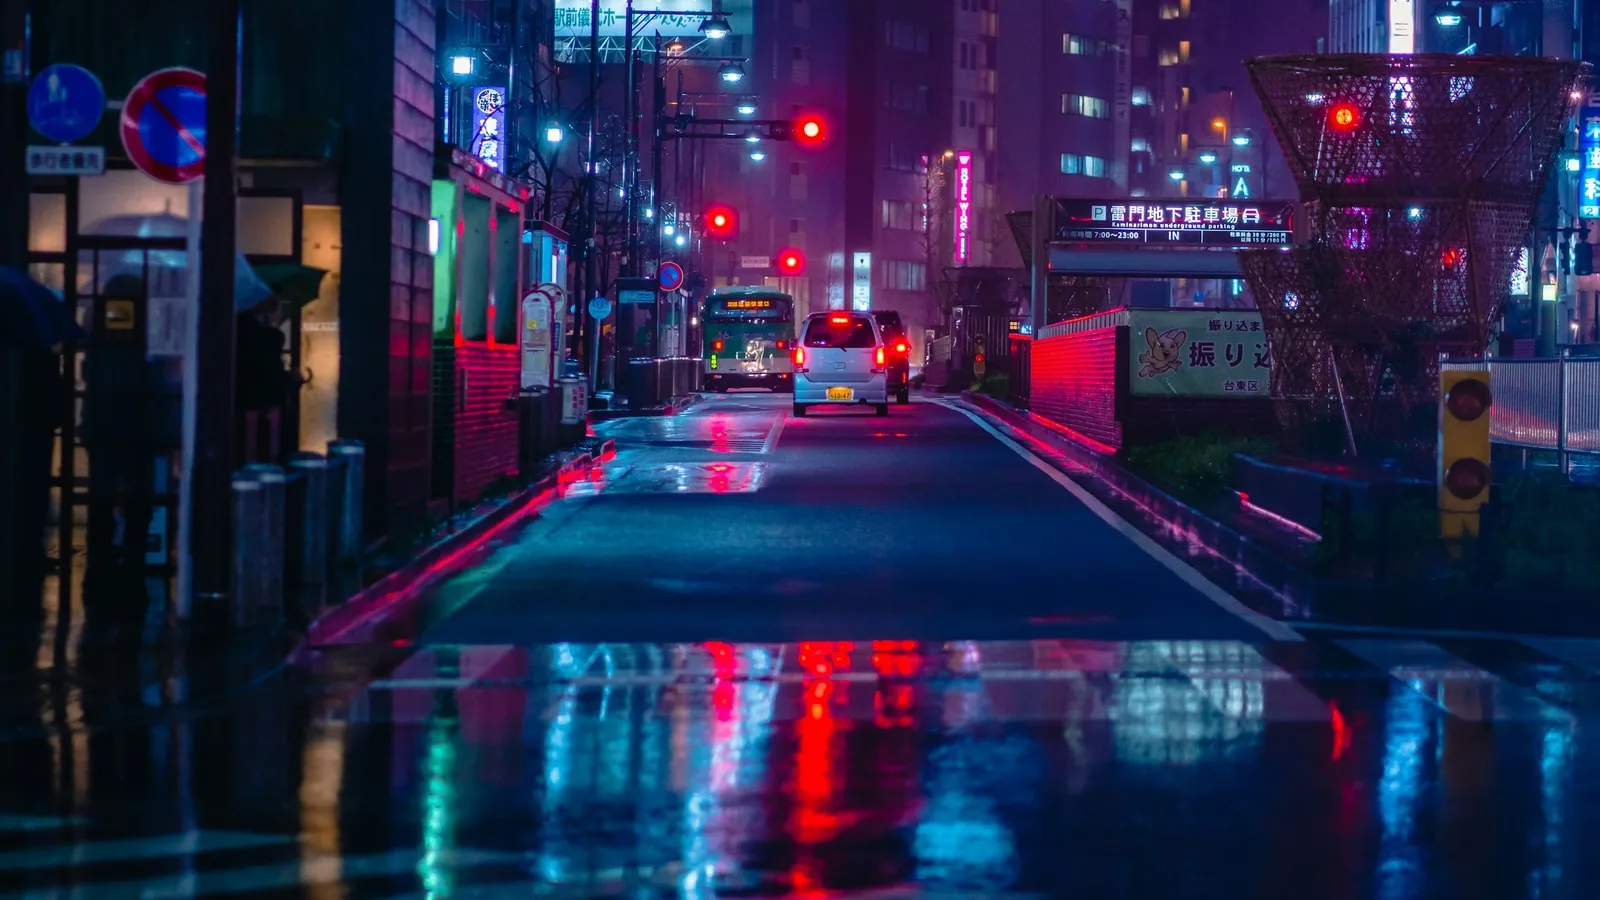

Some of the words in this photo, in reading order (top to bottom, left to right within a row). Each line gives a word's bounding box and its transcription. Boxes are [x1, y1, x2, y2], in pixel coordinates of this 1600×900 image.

[960, 167, 969, 201] HOTEL
[959, 202, 970, 231] WING
[1110, 206, 1238, 223] 雷門地下駐車場
[1111, 221, 1157, 229] Kaminarimon
[1160, 222, 1206, 231] underground
[1208, 223, 1236, 231] parking
[1168, 232, 1180, 241] IN
[1209, 320, 1264, 331] 振り込ま
[1224, 381, 1258, 391] 台東区
